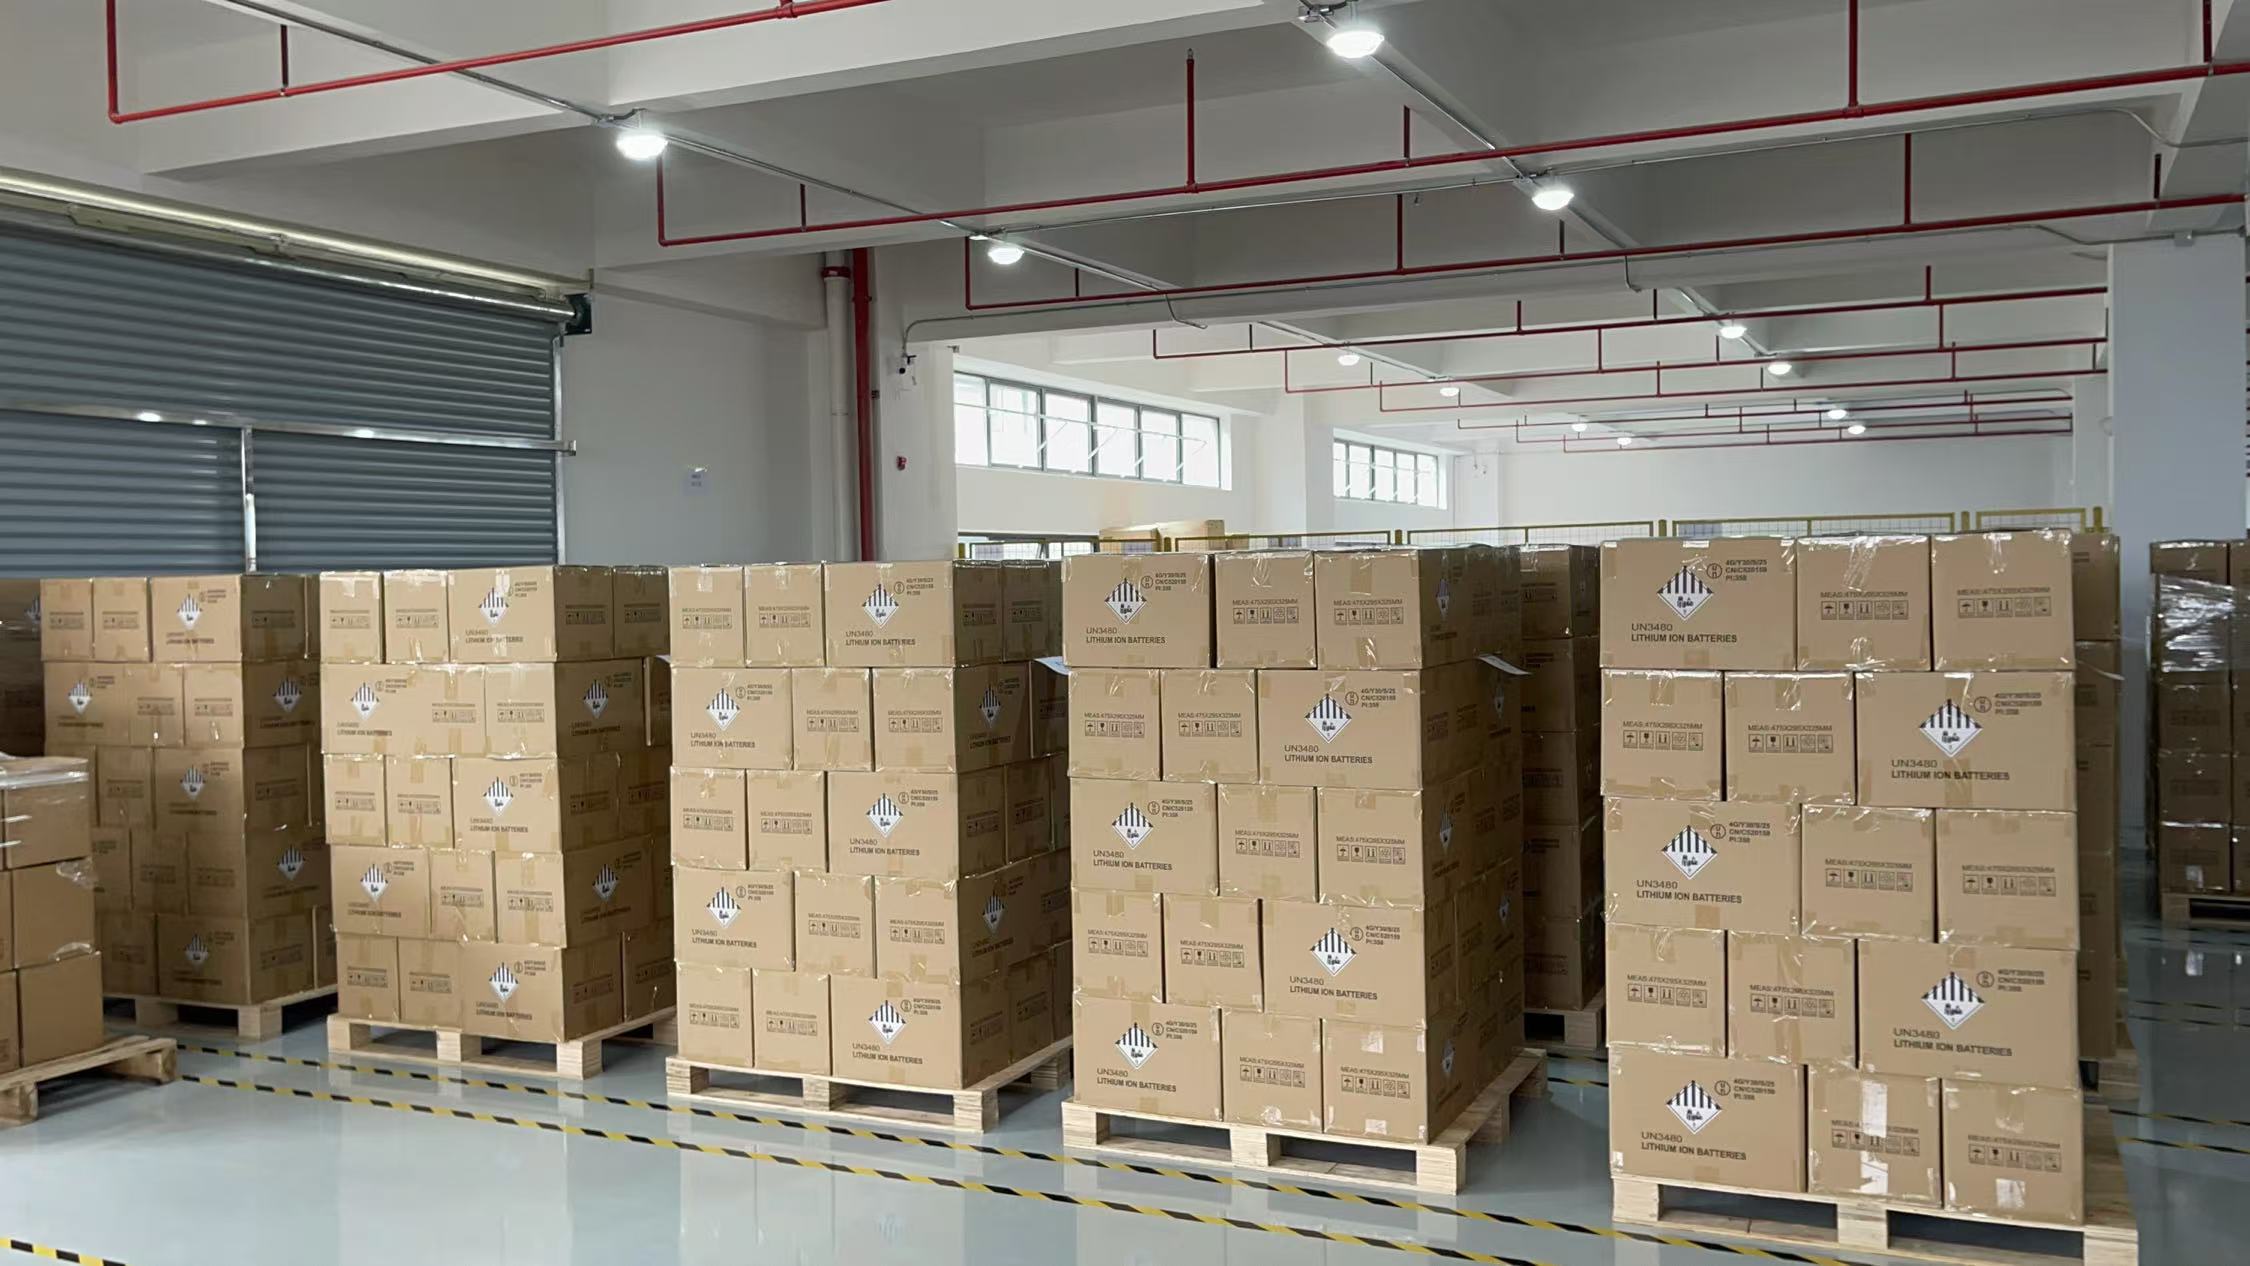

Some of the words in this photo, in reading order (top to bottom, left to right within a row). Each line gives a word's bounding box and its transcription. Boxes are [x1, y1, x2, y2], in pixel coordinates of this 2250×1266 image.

[1632, 623, 1673, 631] UN3480
[1631, 634, 1667, 642] LITHIUM
[1669, 634, 1685, 642] ION
[1688, 634, 1737, 642] BATTERIES
[1316, 755, 1329, 763] ION
[1331, 756, 1372, 764] BATTERIES
[1892, 759, 1938, 768] UN3480
[1891, 771, 1931, 779] LITHIUM
[1933, 771, 1952, 780] ION
[1954, 771, 2010, 780] BATTERIES
[887, 848, 919, 856] BATTERIES
[1093, 850, 1124, 858] UN3480
[1093, 859, 1120, 867] LITHIUM
[1135, 862, 1172, 870] BATTERIES
[1637, 880, 1678, 889] UN3480
[1637, 890, 1672, 900] LITHIUM
[1674, 892, 1690, 901] ION
[1693, 893, 1742, 903] BATTERIES
[692, 937, 714, 945] LITHIUM
[726, 940, 757, 948] BATTERIES
[1290, 976, 1324, 986] UN3480
[1290, 986, 1319, 995] LITHIUM
[1321, 988, 1334, 996] ION
[1336, 989, 1377, 1000] BATTERIES
[1894, 1028, 1940, 1040] UN3480
[1894, 1039, 1934, 1050] LITHIUM
[1936, 1042, 1954, 1052] ION
[1957, 1044, 2012, 1057] BATTERIES
[852, 1052, 876, 1060] LITHIUM
[890, 1055, 922, 1064] BATTERIES
[1097, 1068, 1128, 1078] UN3480
[1097, 1077, 1124, 1086] LITHIUM
[1125, 1080, 1138, 1088] ION
[1139, 1081, 1176, 1092] BATTERIES
[1642, 1131, 1683, 1143] UN3480
[1641, 1142, 1677, 1153] LITHIUM
[1679, 1146, 1695, 1155] ION
[1697, 1148, 1746, 1160] BATTERIES
